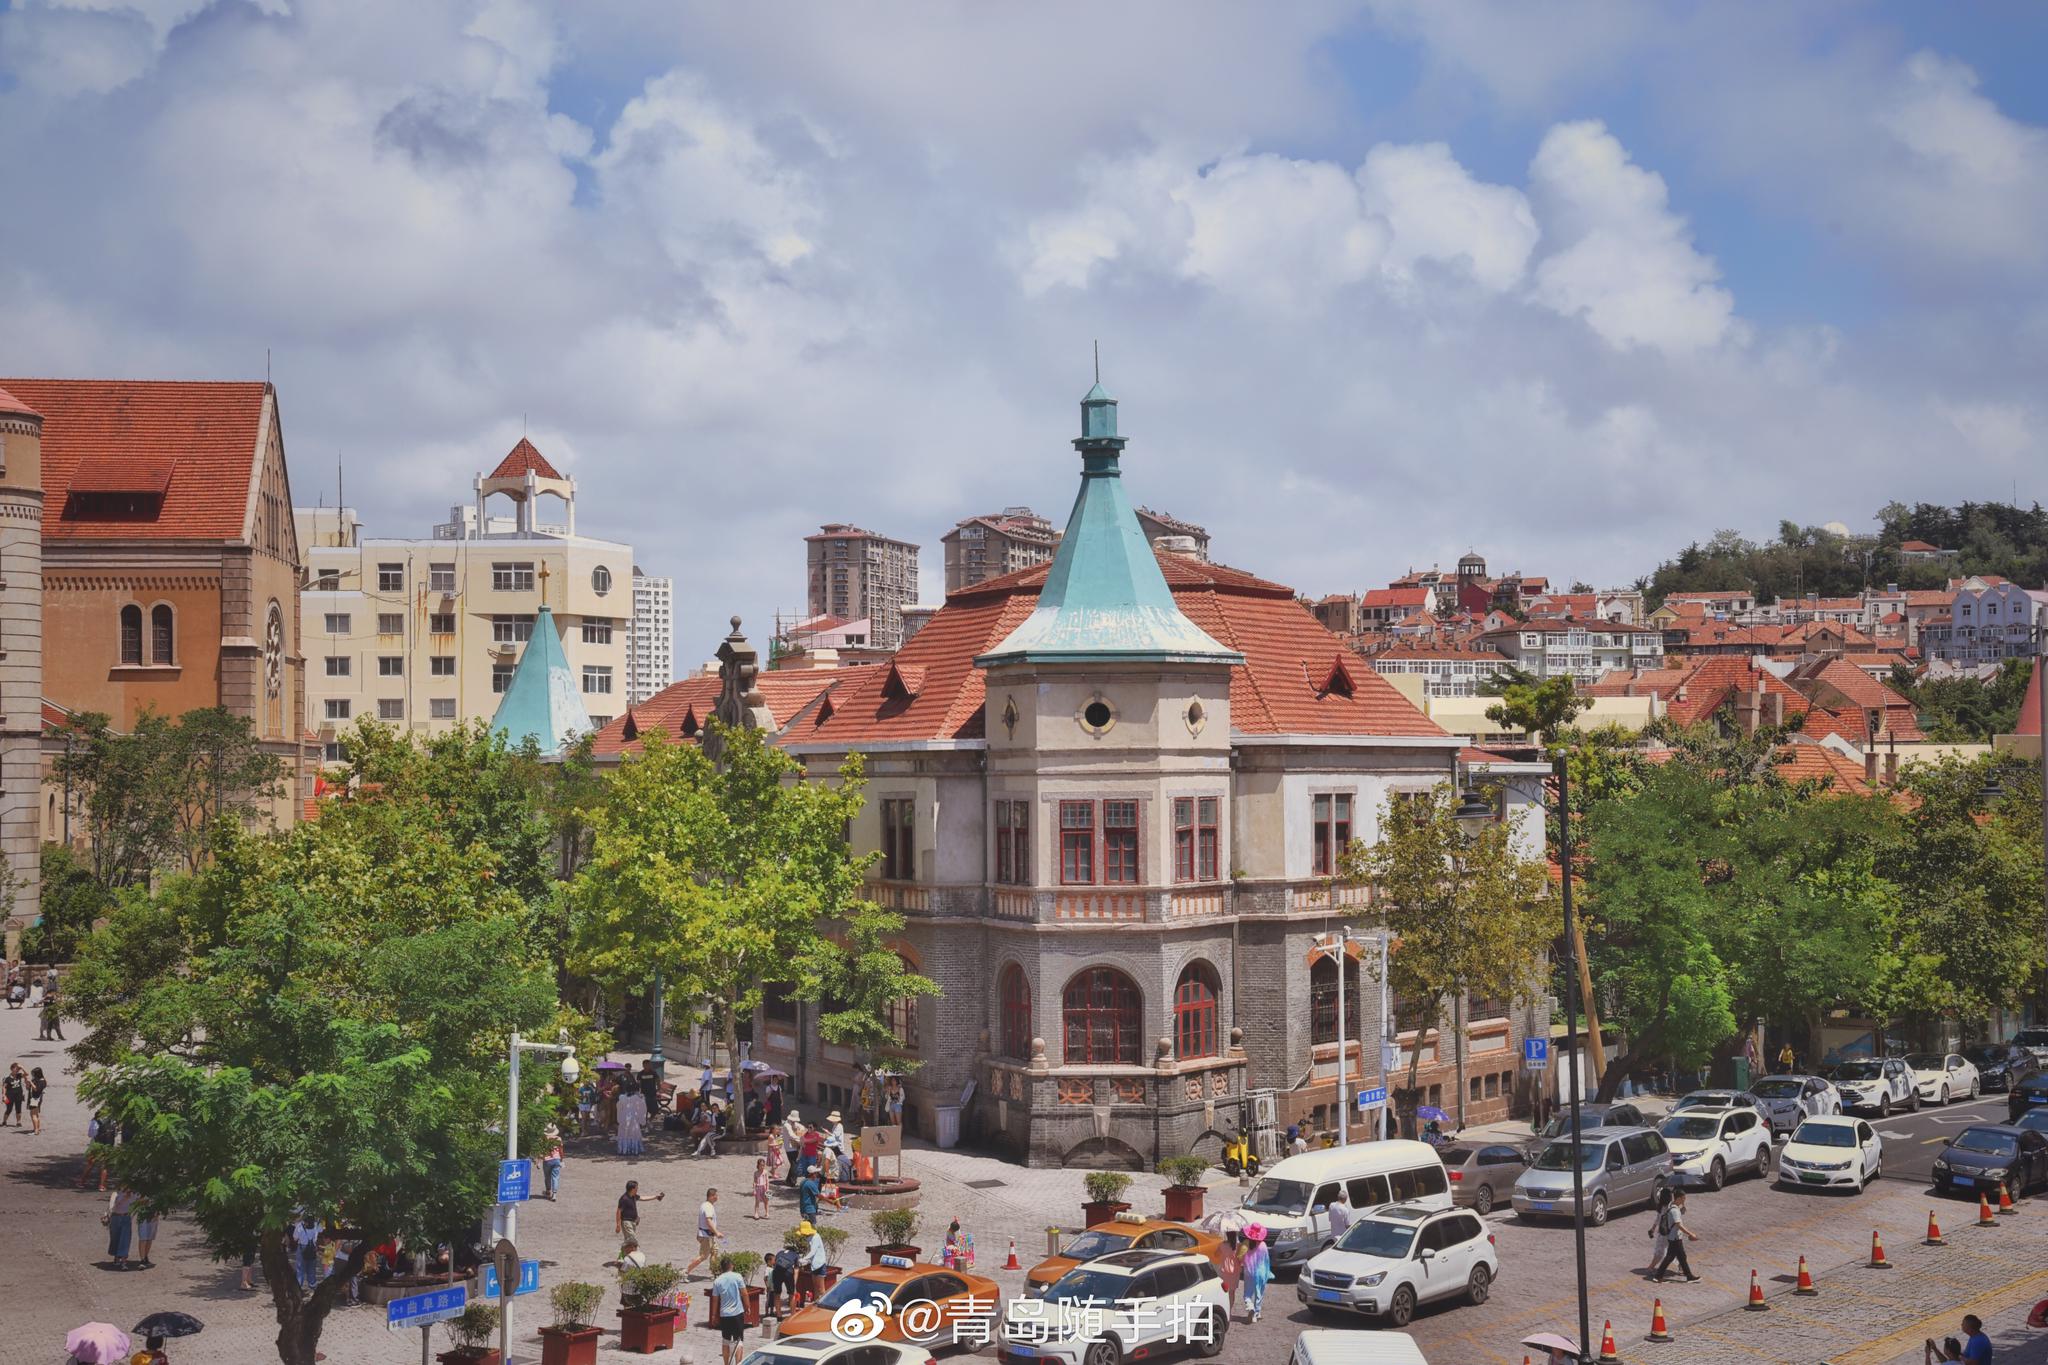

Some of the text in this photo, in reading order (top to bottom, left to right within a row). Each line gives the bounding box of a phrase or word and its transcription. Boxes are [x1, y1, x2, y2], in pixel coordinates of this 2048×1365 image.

[1528, 1040, 1544, 1058] P
[407, 1294, 449, 1316] 曲阜路
